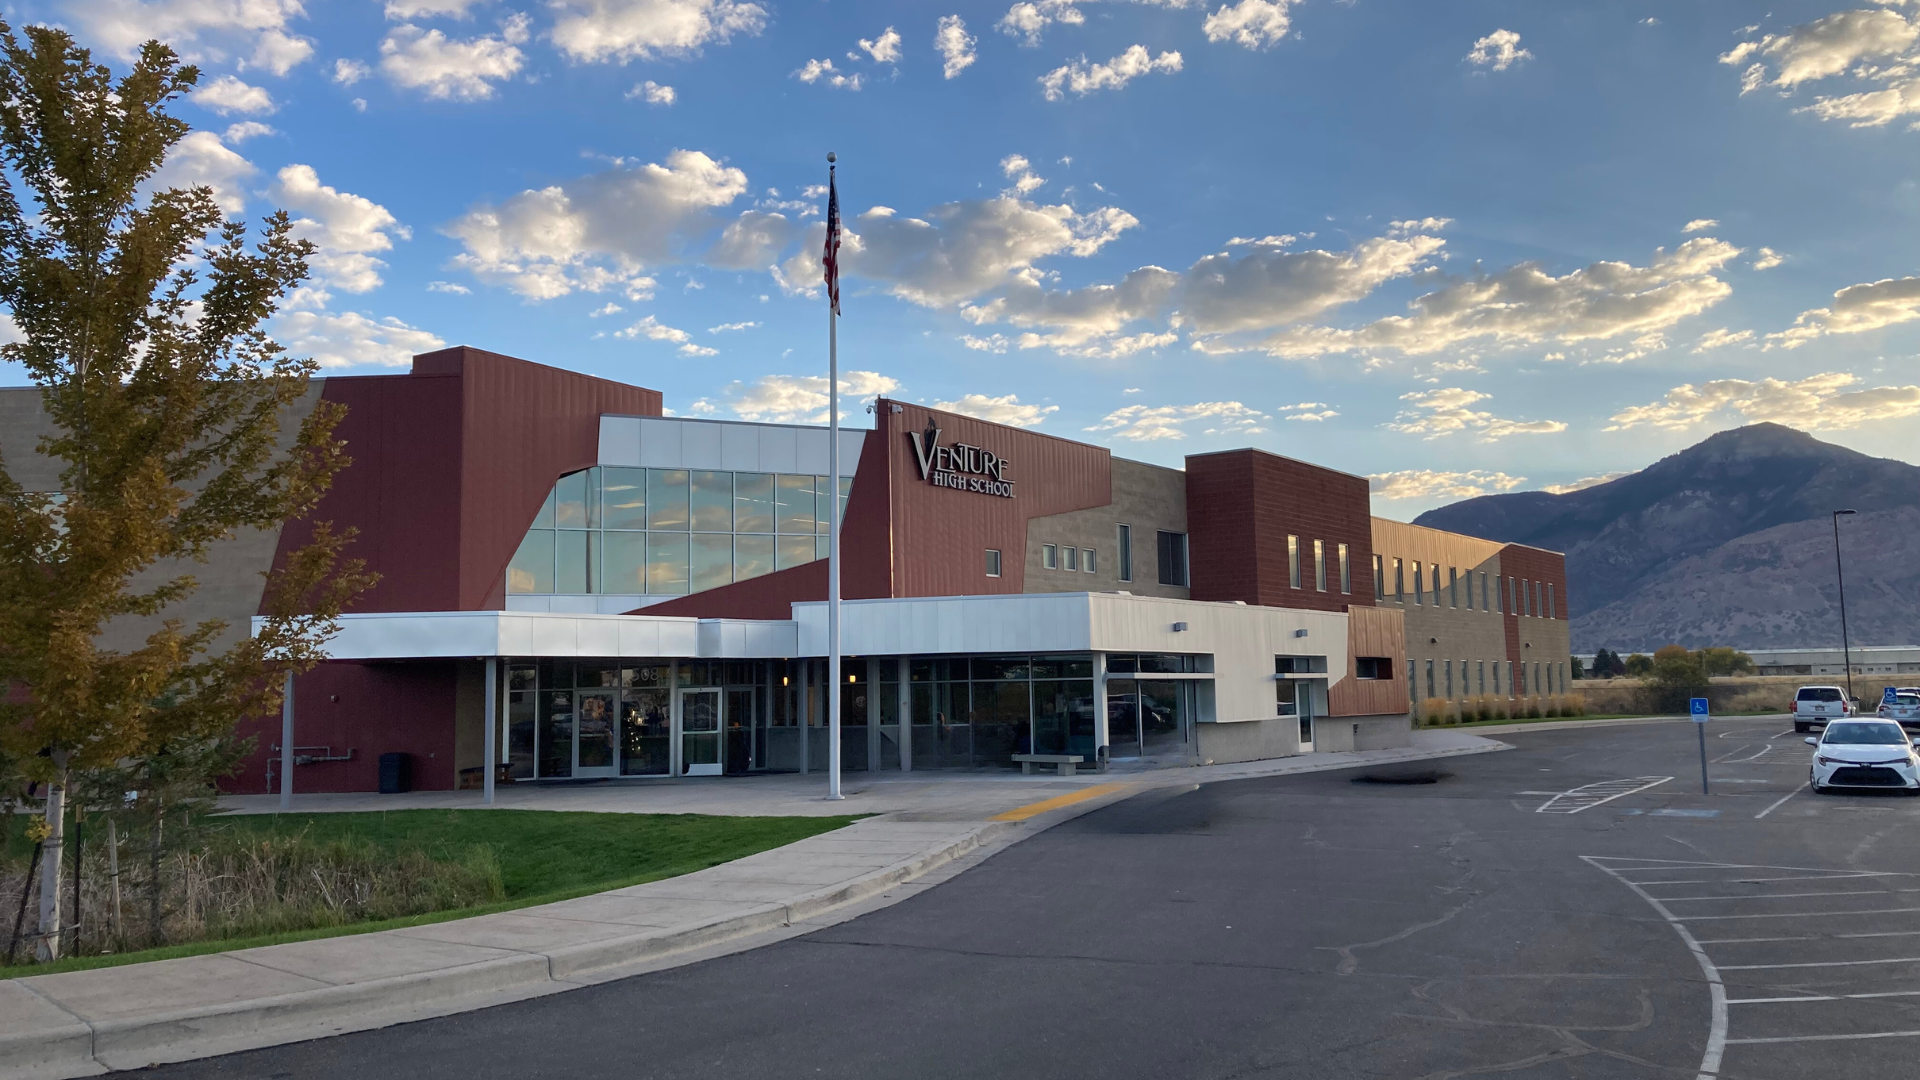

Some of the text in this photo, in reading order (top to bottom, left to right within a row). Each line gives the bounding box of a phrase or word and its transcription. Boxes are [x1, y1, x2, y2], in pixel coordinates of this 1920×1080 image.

[909, 429, 1016, 483] VENTURE
[933, 472, 1016, 498] HIGH SCHOOL
